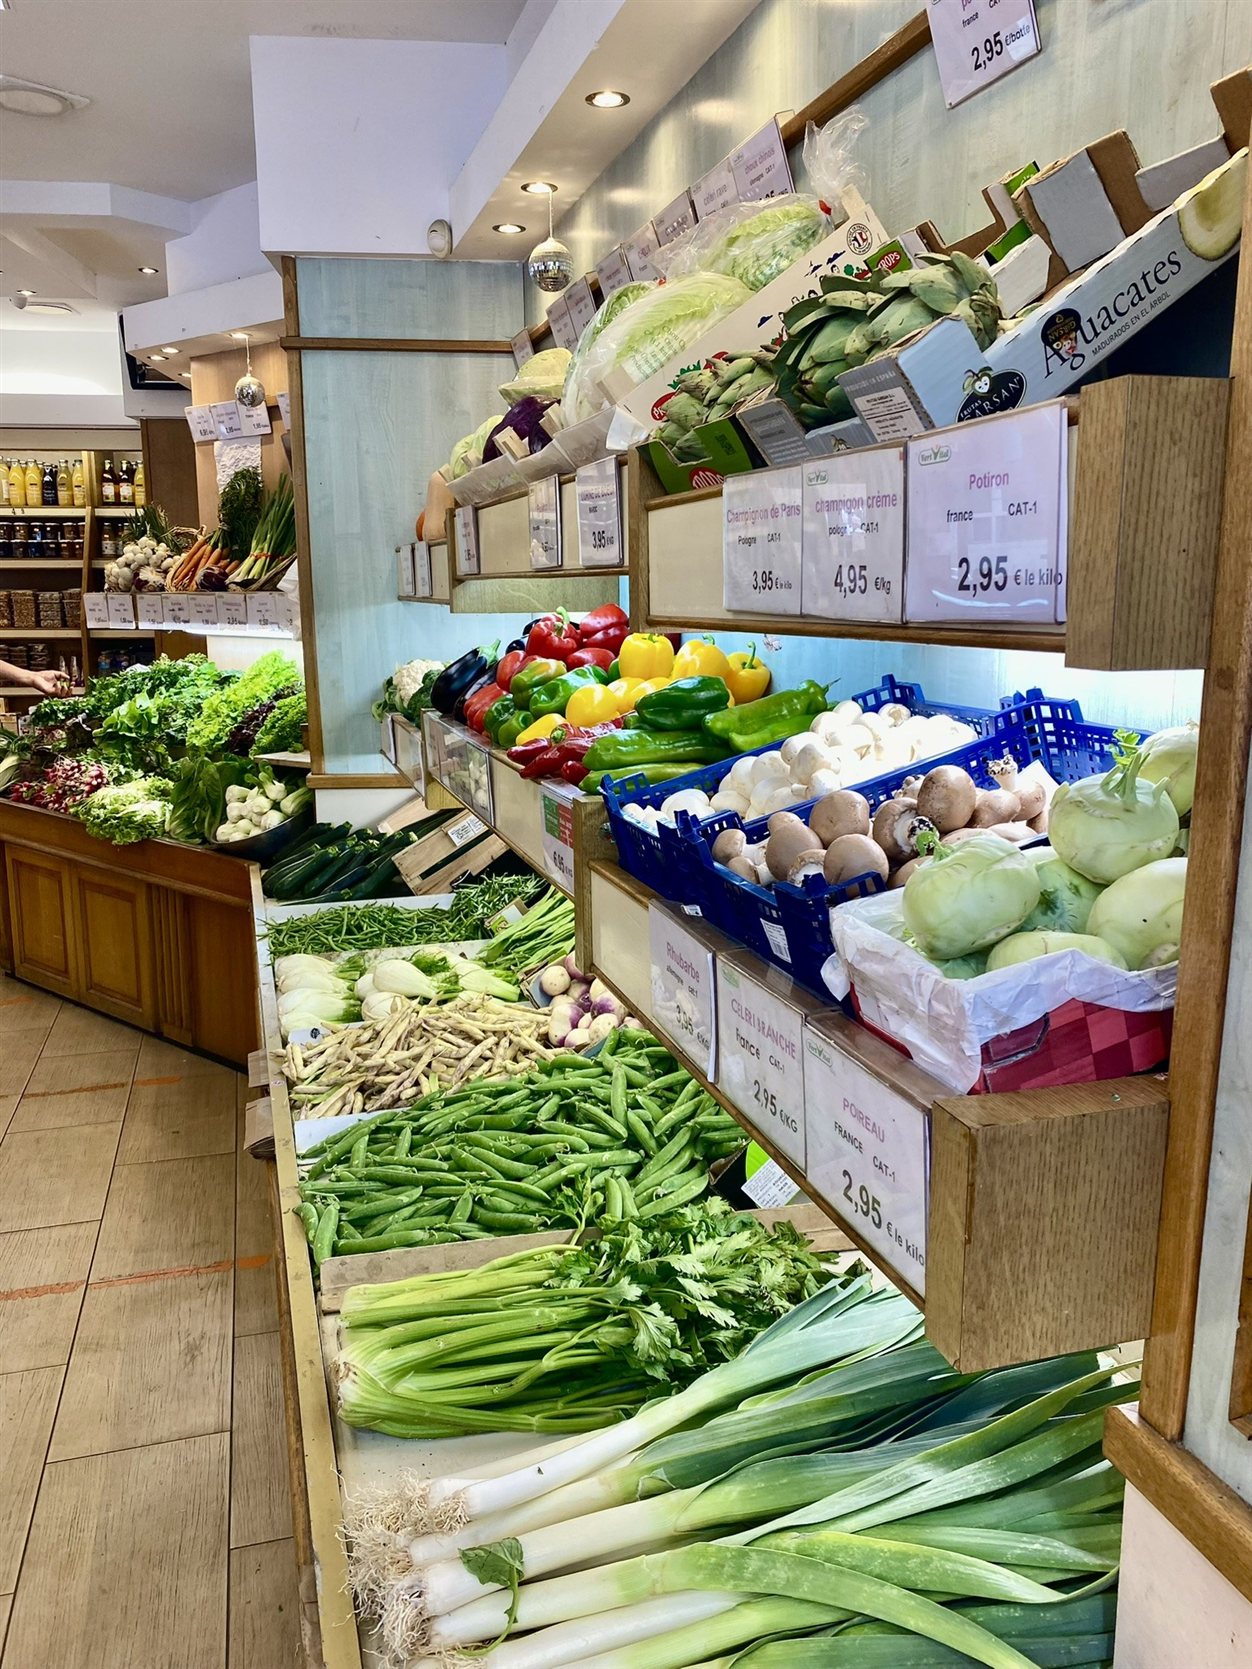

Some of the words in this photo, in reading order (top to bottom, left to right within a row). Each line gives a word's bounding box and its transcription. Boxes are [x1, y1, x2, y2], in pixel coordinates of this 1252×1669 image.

[962, 12, 979, 28] france
[971, 31, 1004, 71] 2,95
[1045, 250, 1182, 379] Aguacates
[1091, 322, 1131, 357] MADURADOS
[1130, 315, 1141, 326] EN
[1140, 309, 1150, 318] EL
[960, 399, 982, 418] FRUTAS
[969, 472, 1010, 490] Potiron
[727, 507, 769, 525] Champignon
[770, 505, 780, 519] de
[781, 501, 801, 518] Paris
[860, 522, 879, 534] CAT-1
[946, 508, 974, 523] france
[1008, 501, 1038, 517] CAT-1
[592, 530, 606, 551] 3,95
[767, 532, 781, 544] CAT-1
[752, 570, 774, 594] 3,95
[774, 577, 779, 590] €
[834, 564, 868, 599] 4,95
[874, 576, 891, 595] €/kg
[958, 556, 1009, 598] 2,95
[1014, 569, 1022, 586] €
[1024, 568, 1035, 586] le
[1038, 568, 1063, 586] kilo
[666, 941, 700, 983] Rhubarbe
[676, 1004, 694, 1036] 3,95
[731, 998, 756, 1028] CELERI
[757, 1016, 797, 1060] BRANCHE
[768, 1054, 785, 1074] CAT-1
[753, 1080, 778, 1117] 2,95
[779, 1108, 798, 1134] €/KG
[842, 1097, 885, 1144] POIREAU
[834, 1121, 864, 1154] FRANCE
[872, 1154, 896, 1184] CAT-1
[842, 1168, 882, 1231] 2,95
[886, 1220, 894, 1238] €
[894, 1227, 904, 1249] le
[904, 1238, 926, 1268] kilo
